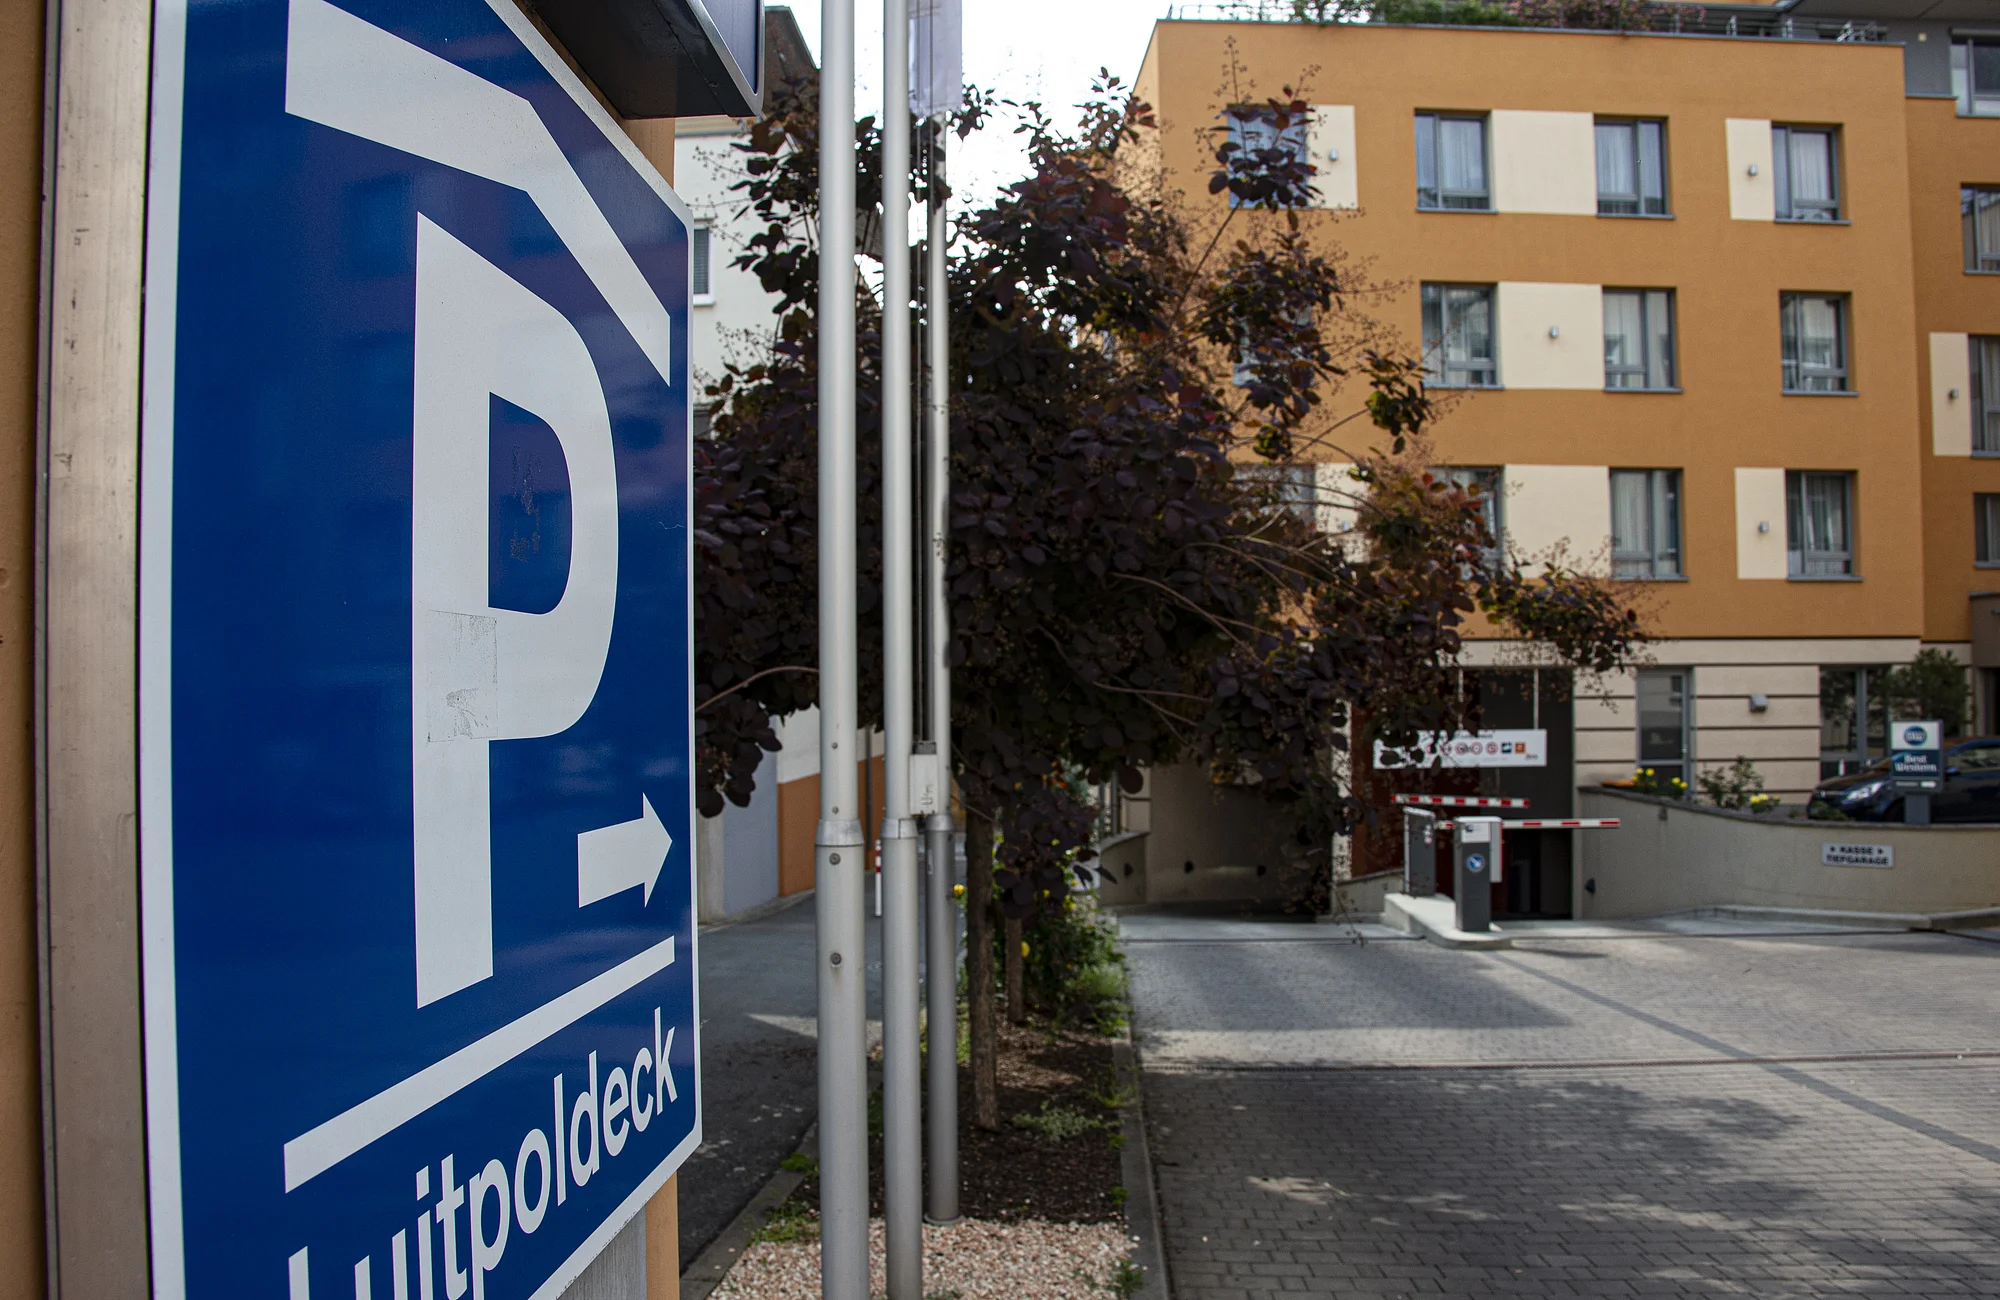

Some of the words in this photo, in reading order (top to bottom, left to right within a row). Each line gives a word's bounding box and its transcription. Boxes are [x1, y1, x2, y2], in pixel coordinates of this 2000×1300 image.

[413, 211, 618, 1009] P
[1904, 754, 1927, 764] Best
[1894, 763, 1937, 773] Western
[1840, 845, 1873, 855] KASSE
[1826, 854, 1889, 866] TIEFGARAGE
[287, 1006, 678, 1300] itpoldeck
